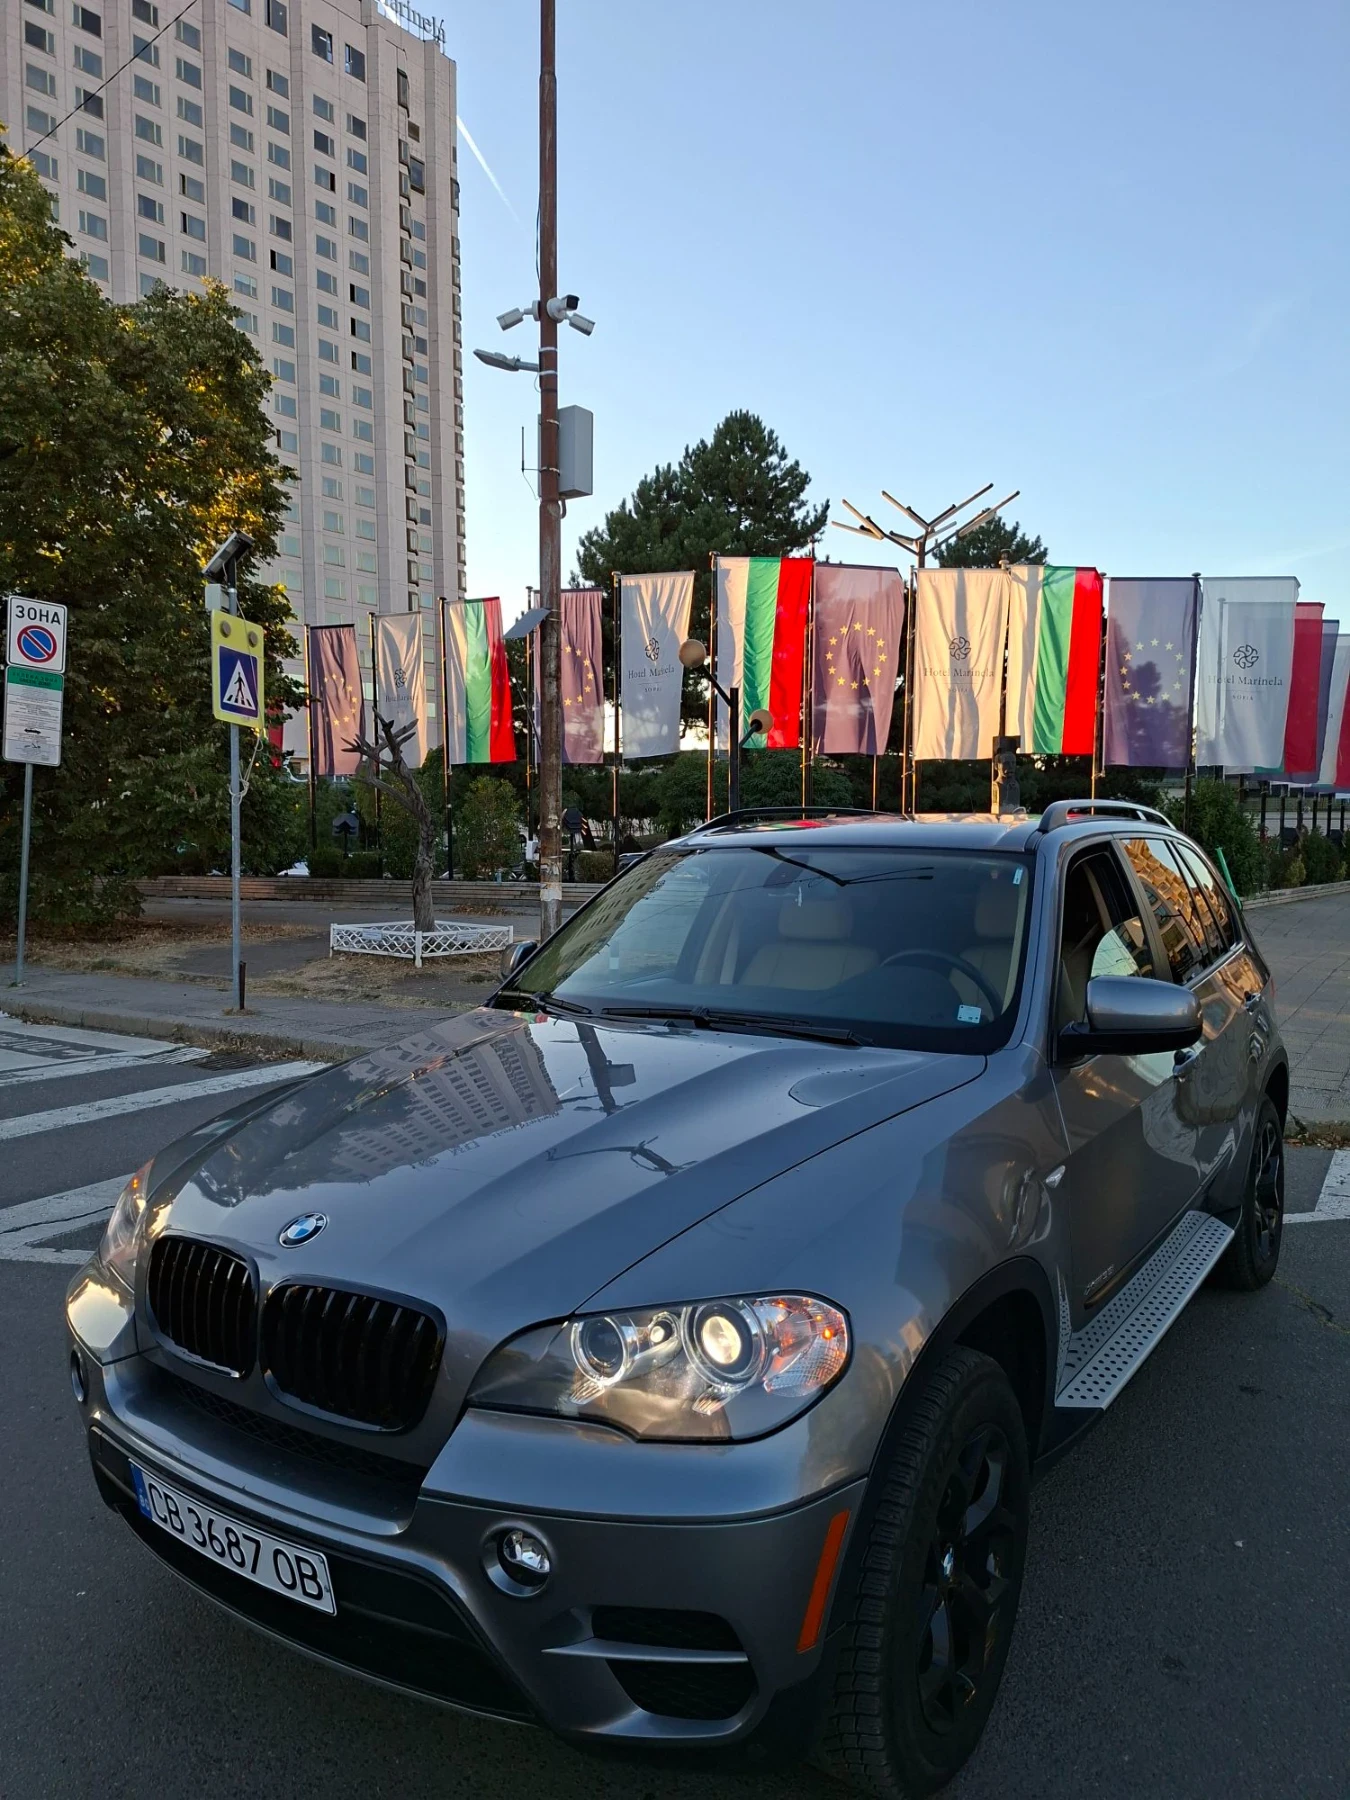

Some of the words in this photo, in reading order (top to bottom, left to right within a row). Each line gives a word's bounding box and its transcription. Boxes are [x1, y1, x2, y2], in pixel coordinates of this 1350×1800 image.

[15, 604, 61, 625] ЗОНА
[924, 667, 950, 677] Hotel
[953, 667, 995, 677] Marinela
[1208, 675, 1235, 685] Hotel
[1238, 676, 1283, 686] Marinela
[147, 1481, 185, 1535] CB
[188, 1506, 262, 1575] 3687
[273, 1548, 324, 1601] OB
